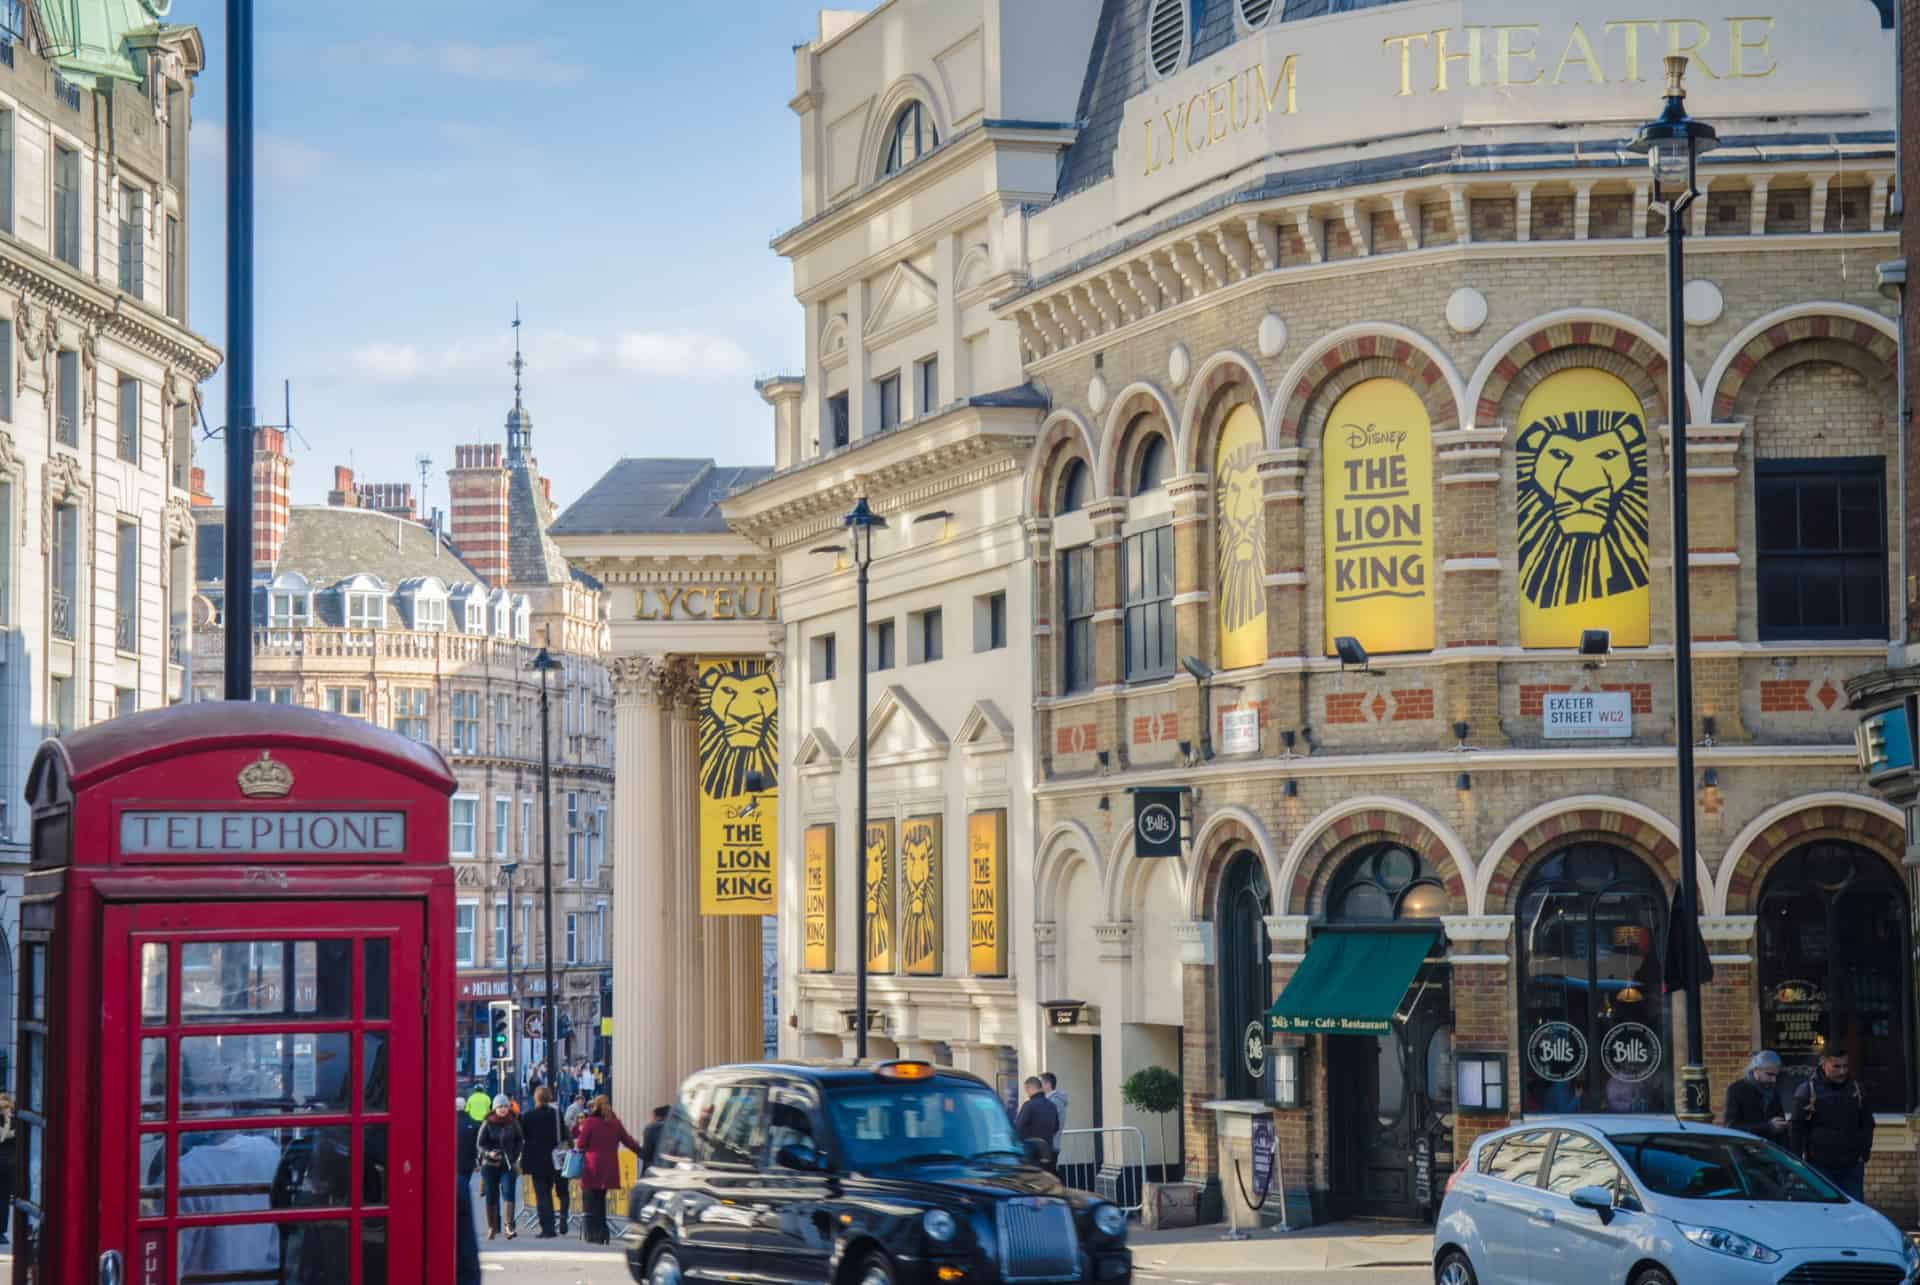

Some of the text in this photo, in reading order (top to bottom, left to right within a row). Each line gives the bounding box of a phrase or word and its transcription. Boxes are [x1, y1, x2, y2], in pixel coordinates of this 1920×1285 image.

[1144, 16, 1777, 176] LYCEUM THEATRE
[1344, 454, 1408, 491] THE
[1336, 504, 1421, 542] LION
[1335, 554, 1424, 592] KING
[1550, 697, 1593, 710] EXETER
[1551, 711, 1625, 724] STREET WC2
[132, 816, 394, 850] TELEPHONE
[723, 823, 762, 842] THE
[717, 849, 770, 869] LION
[973, 857, 991, 879] THE
[716, 877, 772, 896] KING
[808, 867, 822, 885] THE
[807, 894, 824, 913] LION
[971, 888, 994, 910] LION
[971, 919, 995, 942] KING
[1294, 1017, 1309, 1028] Bar
[1341, 1018, 1389, 1030] Restaurant
[1540, 1038, 1574, 1062] Bill's
[1612, 1038, 1648, 1062] Bill's
